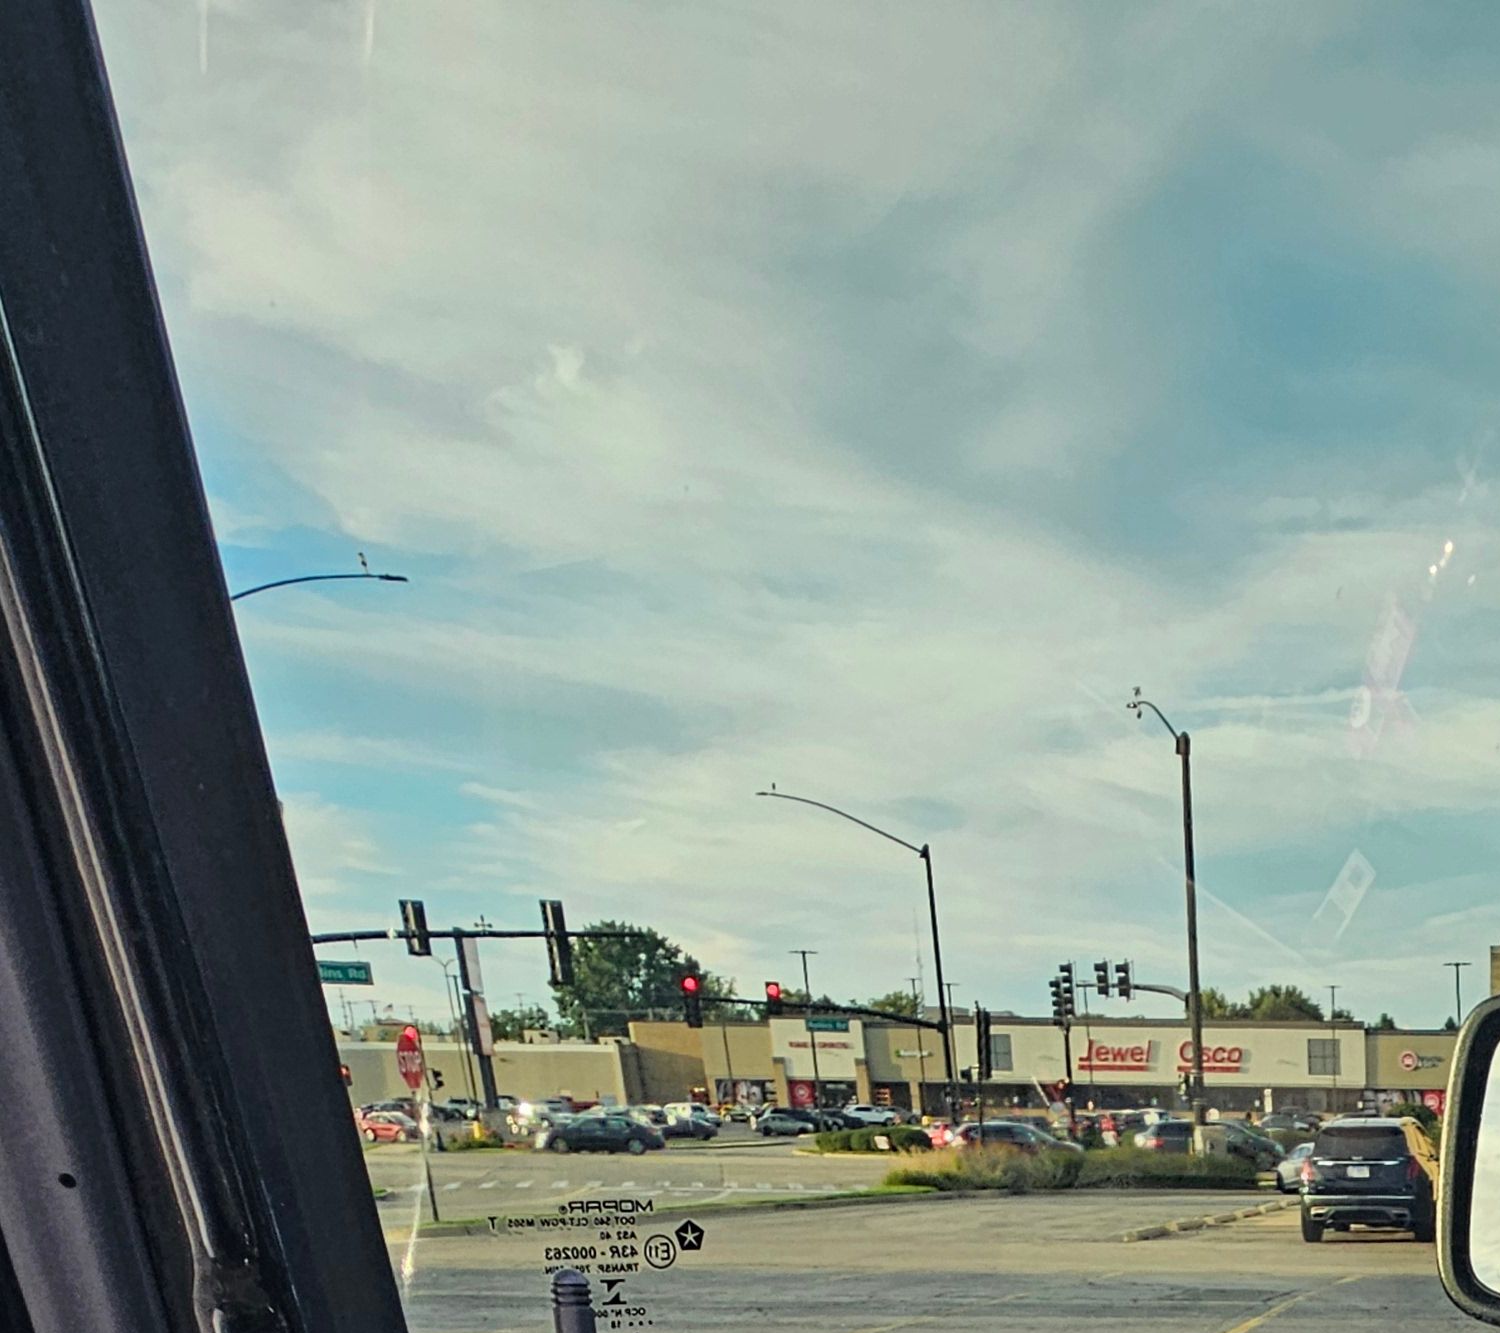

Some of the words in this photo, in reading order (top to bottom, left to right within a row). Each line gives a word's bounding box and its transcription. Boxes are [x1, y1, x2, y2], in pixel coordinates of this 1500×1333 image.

[348, 968, 367, 979] Rd
[1079, 1039, 1152, 1063] Jewel
[1179, 1041, 1242, 1063] Osco
